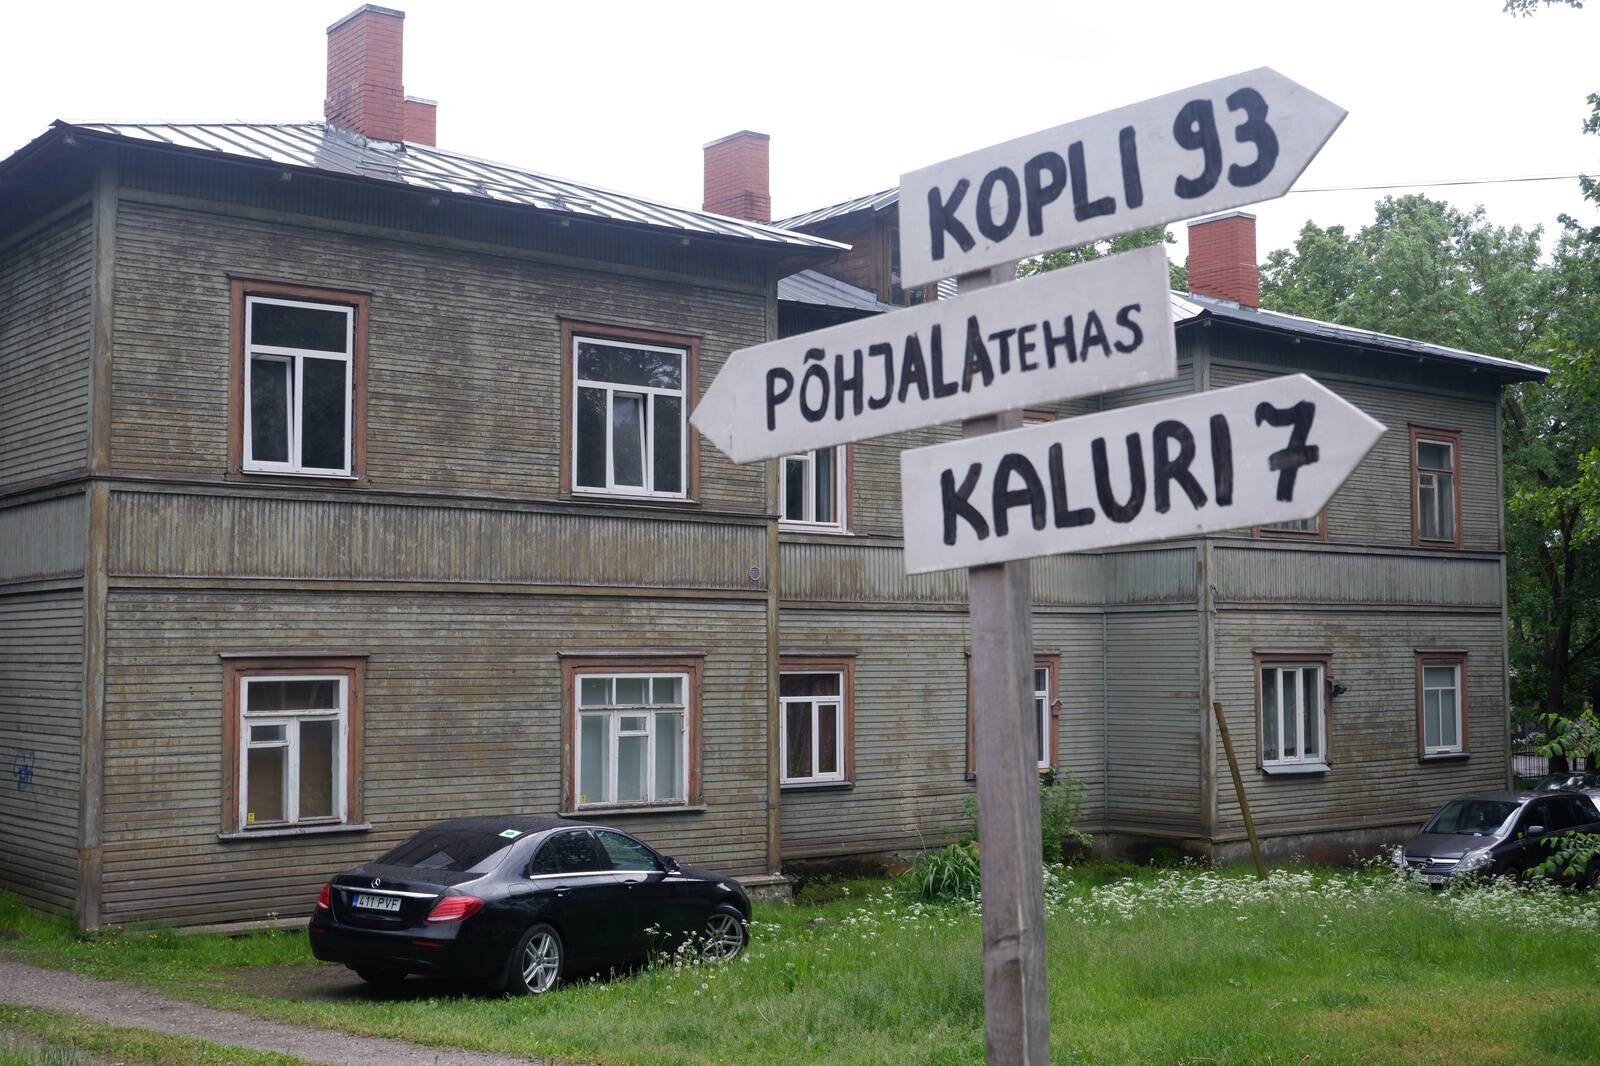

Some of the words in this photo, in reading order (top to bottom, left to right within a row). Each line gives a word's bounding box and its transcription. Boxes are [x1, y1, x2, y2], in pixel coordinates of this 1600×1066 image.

[927, 125, 1144, 261] KOPLI
[1172, 87, 1280, 200] 93
[765, 303, 1144, 432] PÕHJALATEHAS
[940, 413, 1234, 547] KALURI
[1254, 399, 1320, 503] 7
[359, 895, 375, 907] 411
[377, 897, 399, 909] PVF
